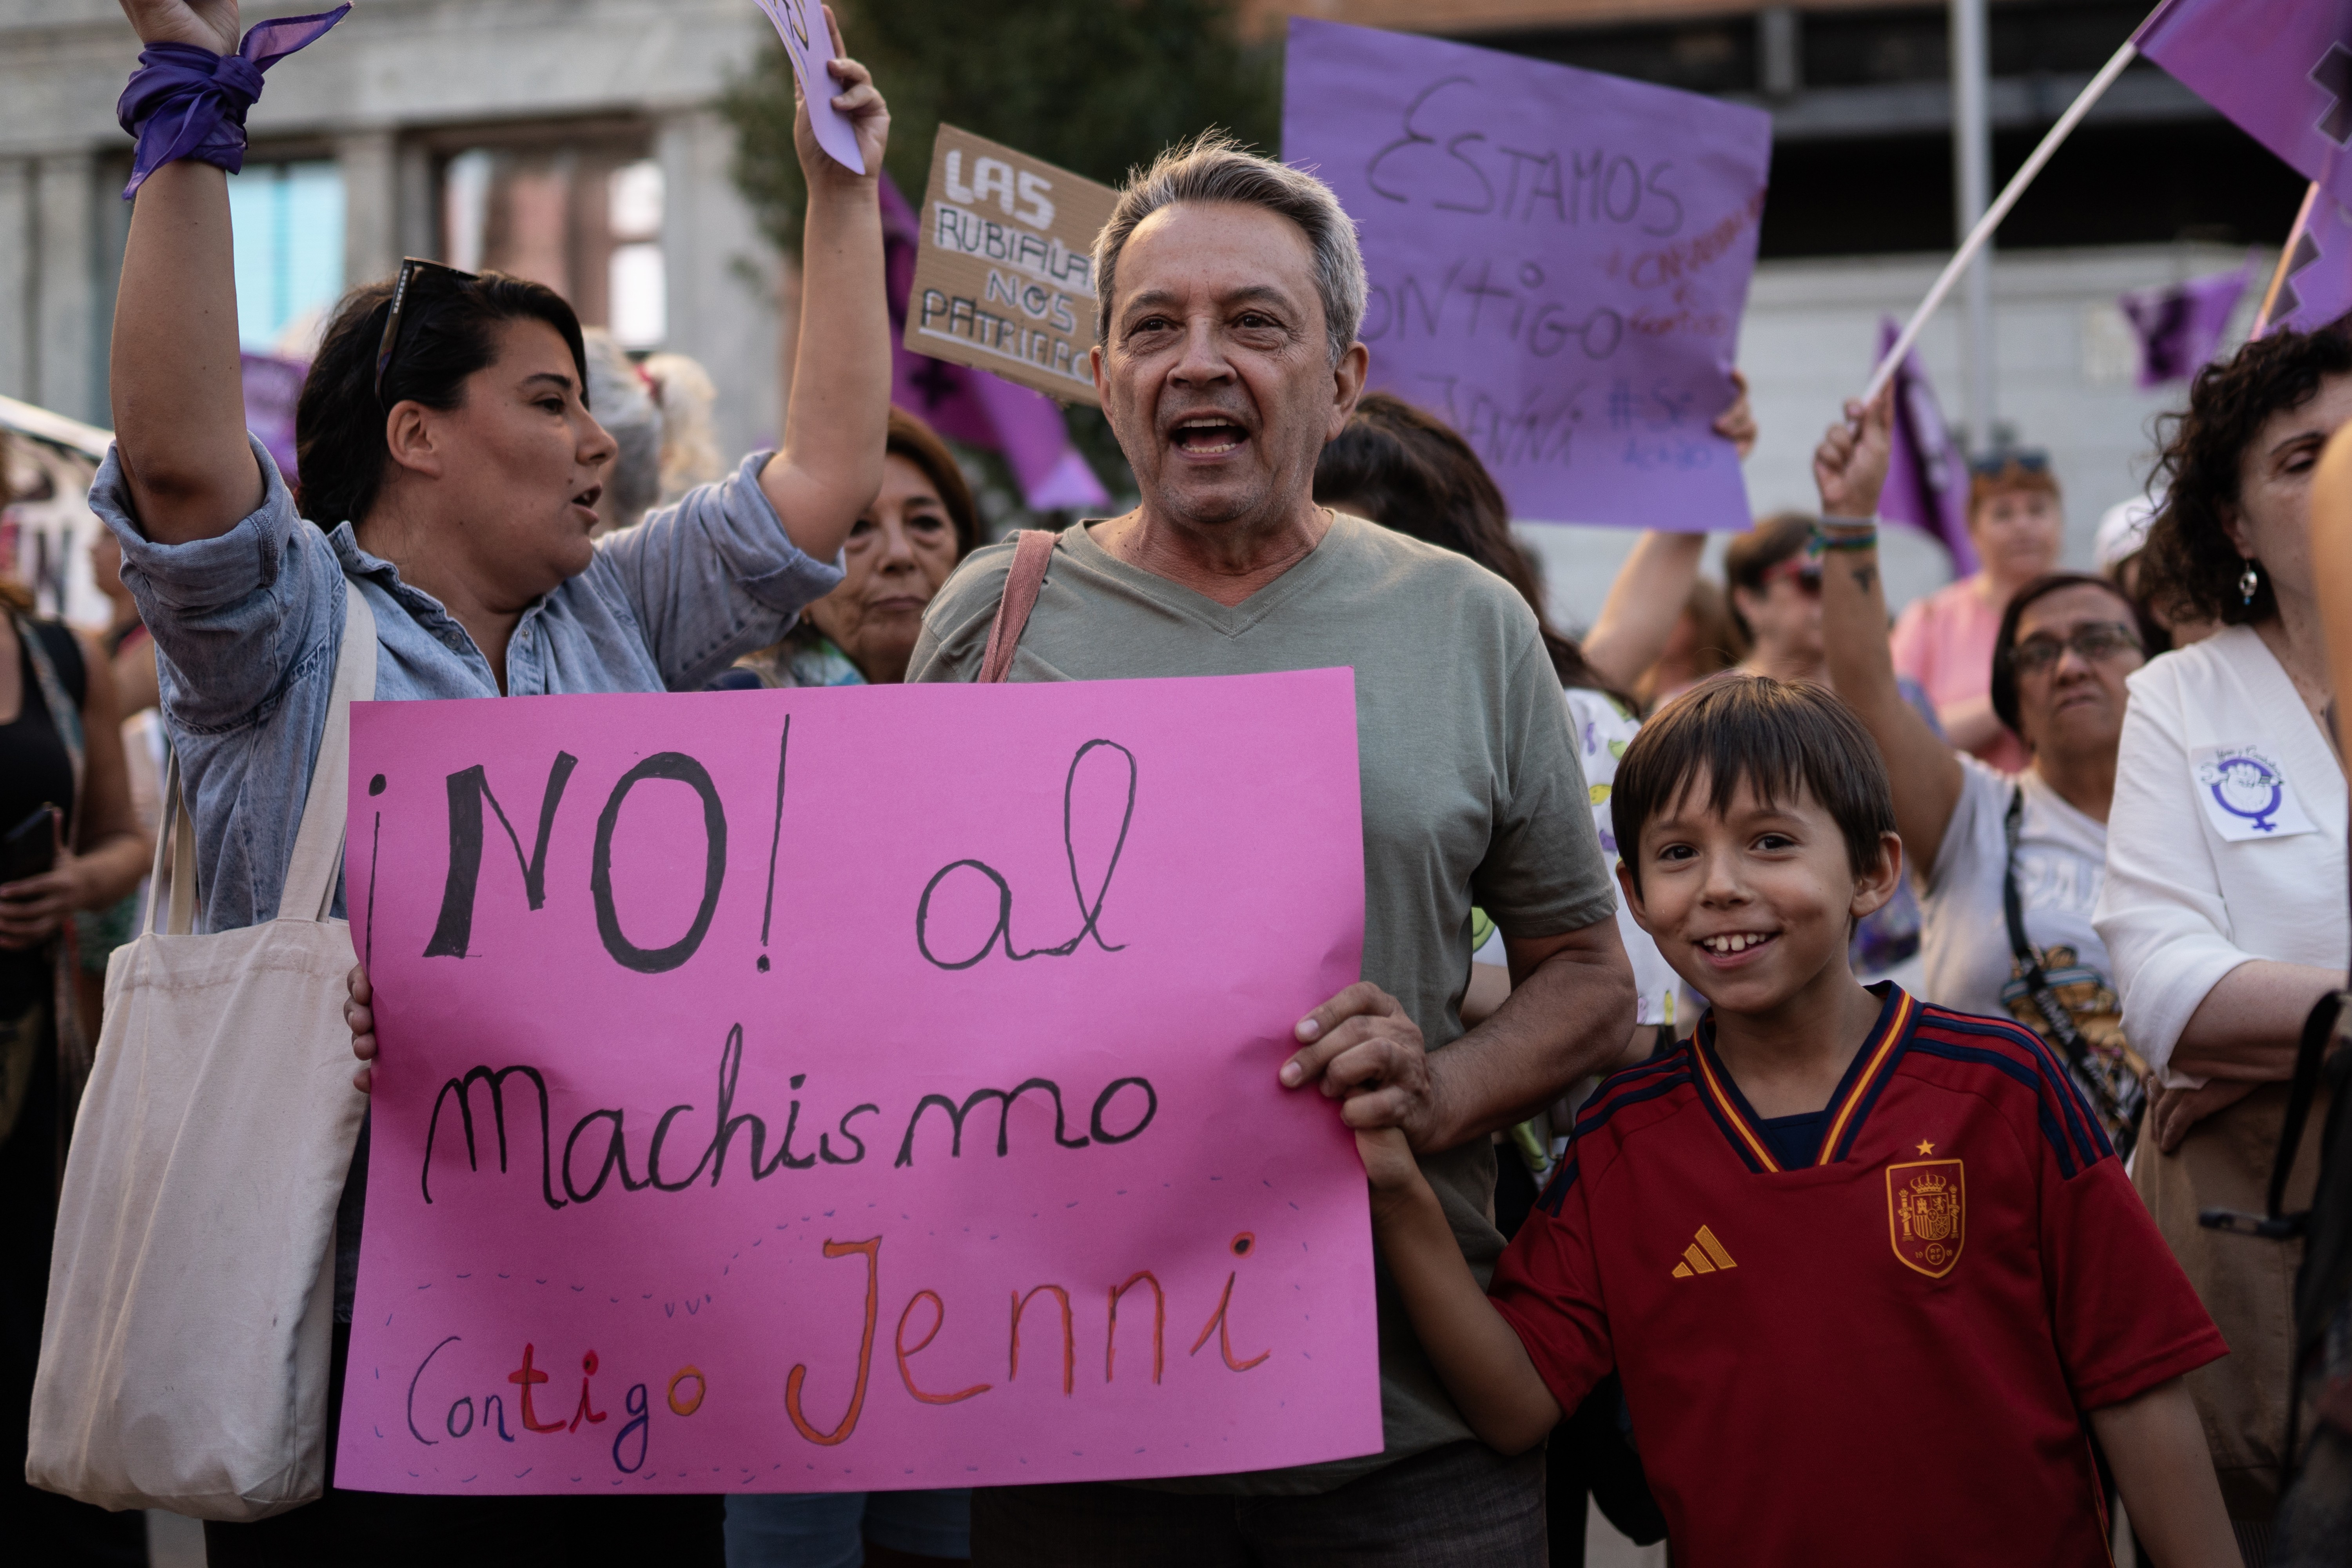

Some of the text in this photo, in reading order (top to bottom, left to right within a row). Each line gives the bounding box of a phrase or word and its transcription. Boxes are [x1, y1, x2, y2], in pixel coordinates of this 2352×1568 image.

[945, 149, 1055, 231] LAS
[1367, 75, 1684, 237] ESTAMOS
[940, 208, 1094, 288] RUBIALA
[984, 271, 1077, 335] NOS
[365, 713, 1137, 979] ¡NO! al
[407, 1230, 1272, 1474] Contigo Jenni
